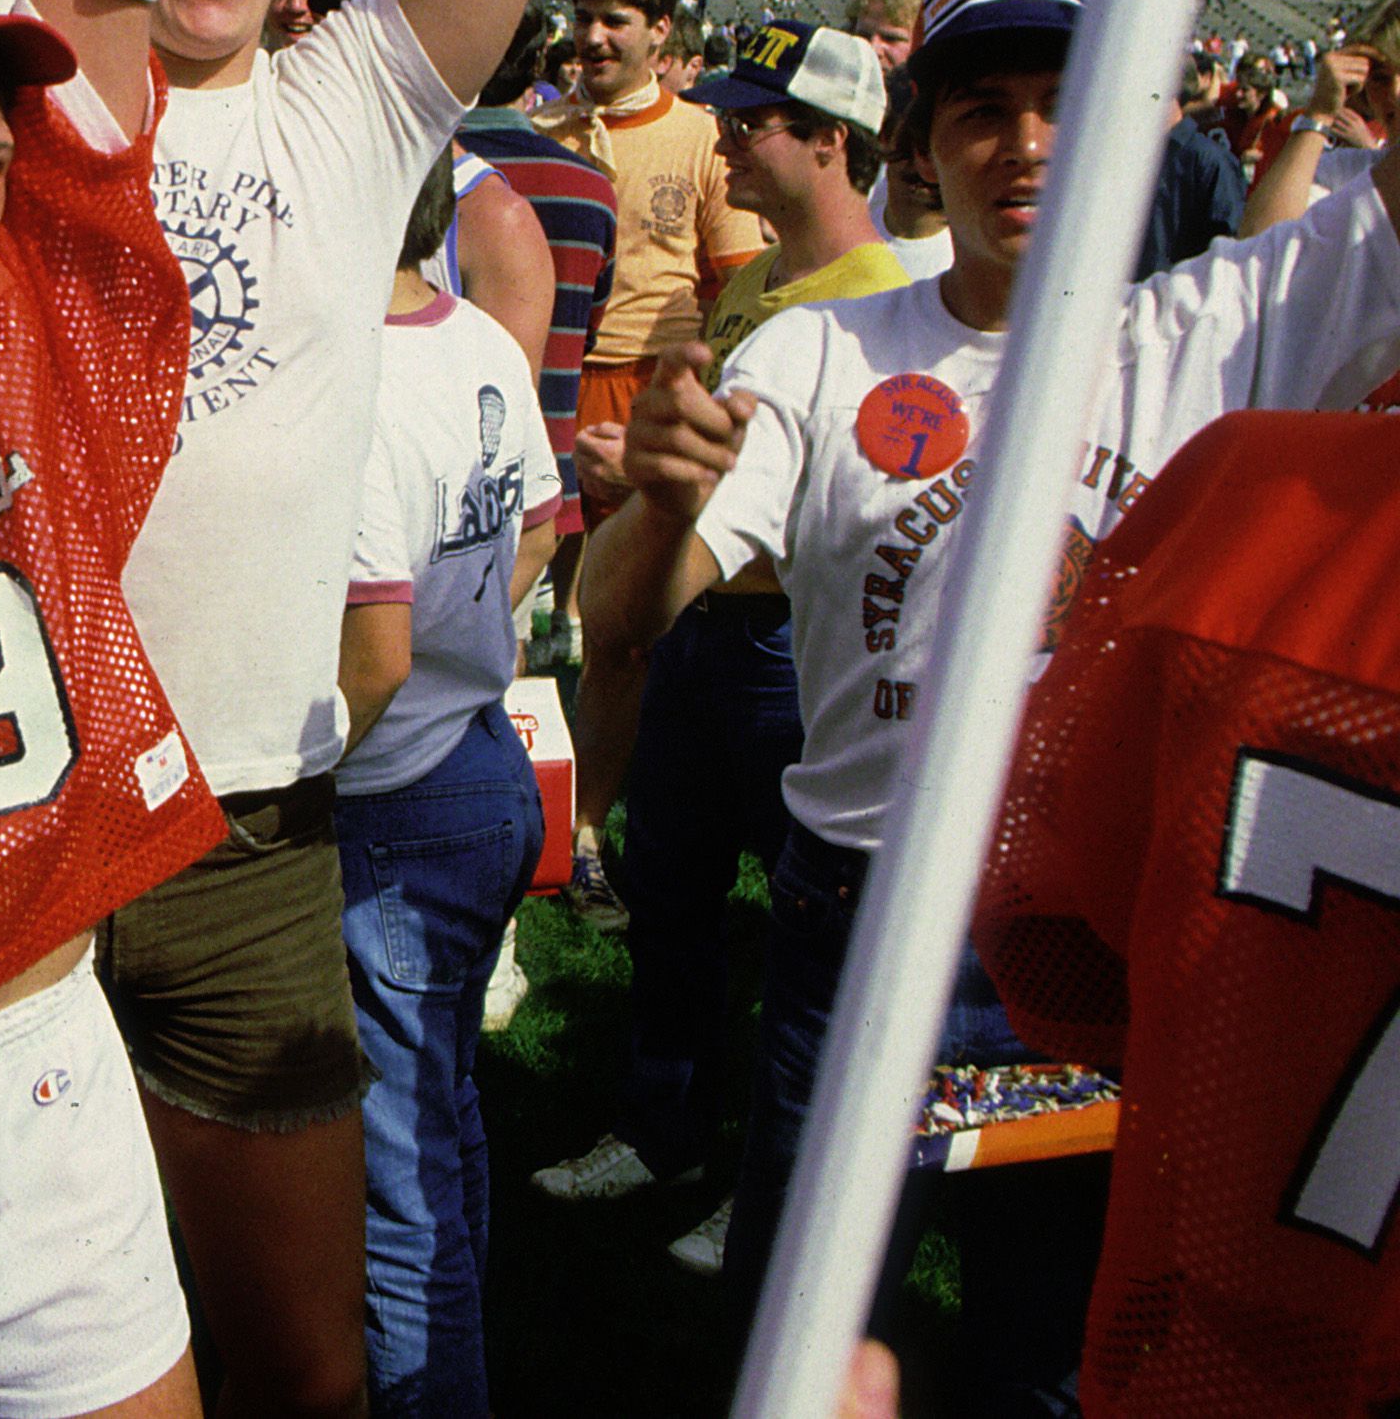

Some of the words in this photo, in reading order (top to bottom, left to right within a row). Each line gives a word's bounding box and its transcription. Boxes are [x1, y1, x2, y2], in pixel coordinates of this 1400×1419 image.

[153, 160, 207, 191] TER
[168, 236, 215, 257] TARY
[862, 458, 978, 654] SYRACUS
[1218, 744, 1400, 1262] 7
